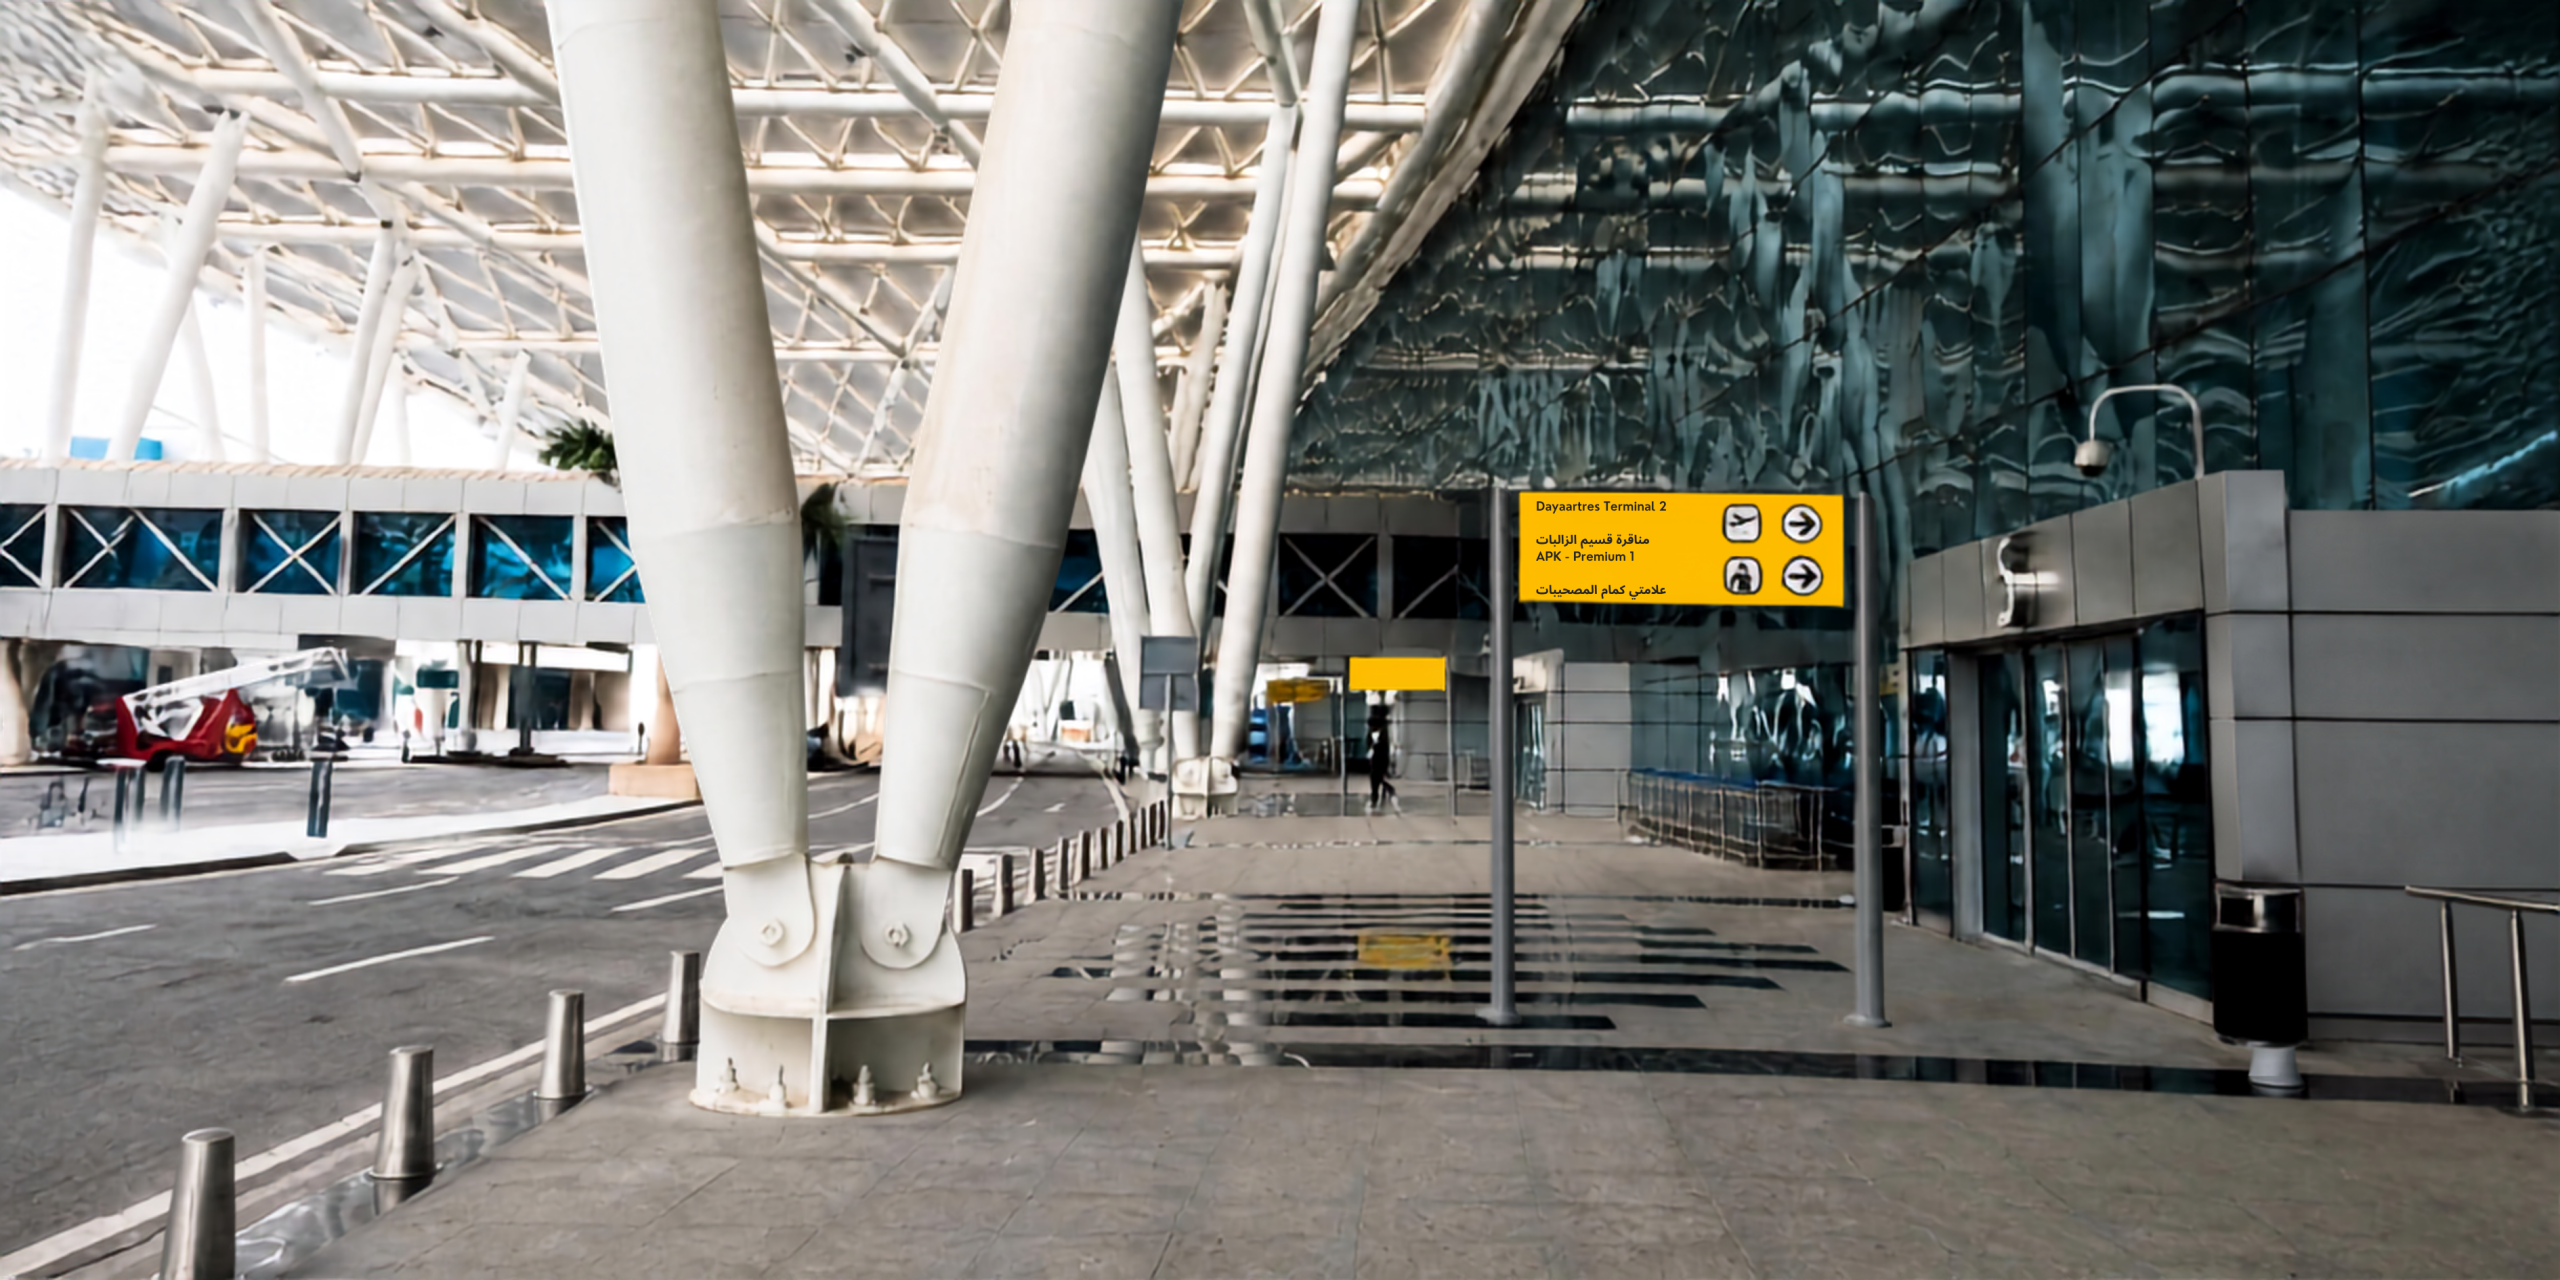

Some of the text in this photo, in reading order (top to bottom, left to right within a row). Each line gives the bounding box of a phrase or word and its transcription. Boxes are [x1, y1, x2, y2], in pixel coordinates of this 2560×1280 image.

[1536, 500, 1667, 514] Dayaartres Terminal 2
[1536, 533, 1650, 549] مناقرة قسيم الزالبات
[1536, 551, 1562, 562] APK
[1573, 551, 1626, 562] Premium
[1629, 551, 1635, 562] 1
[1536, 584, 1666, 600] علامتي كمام المصحيبات
